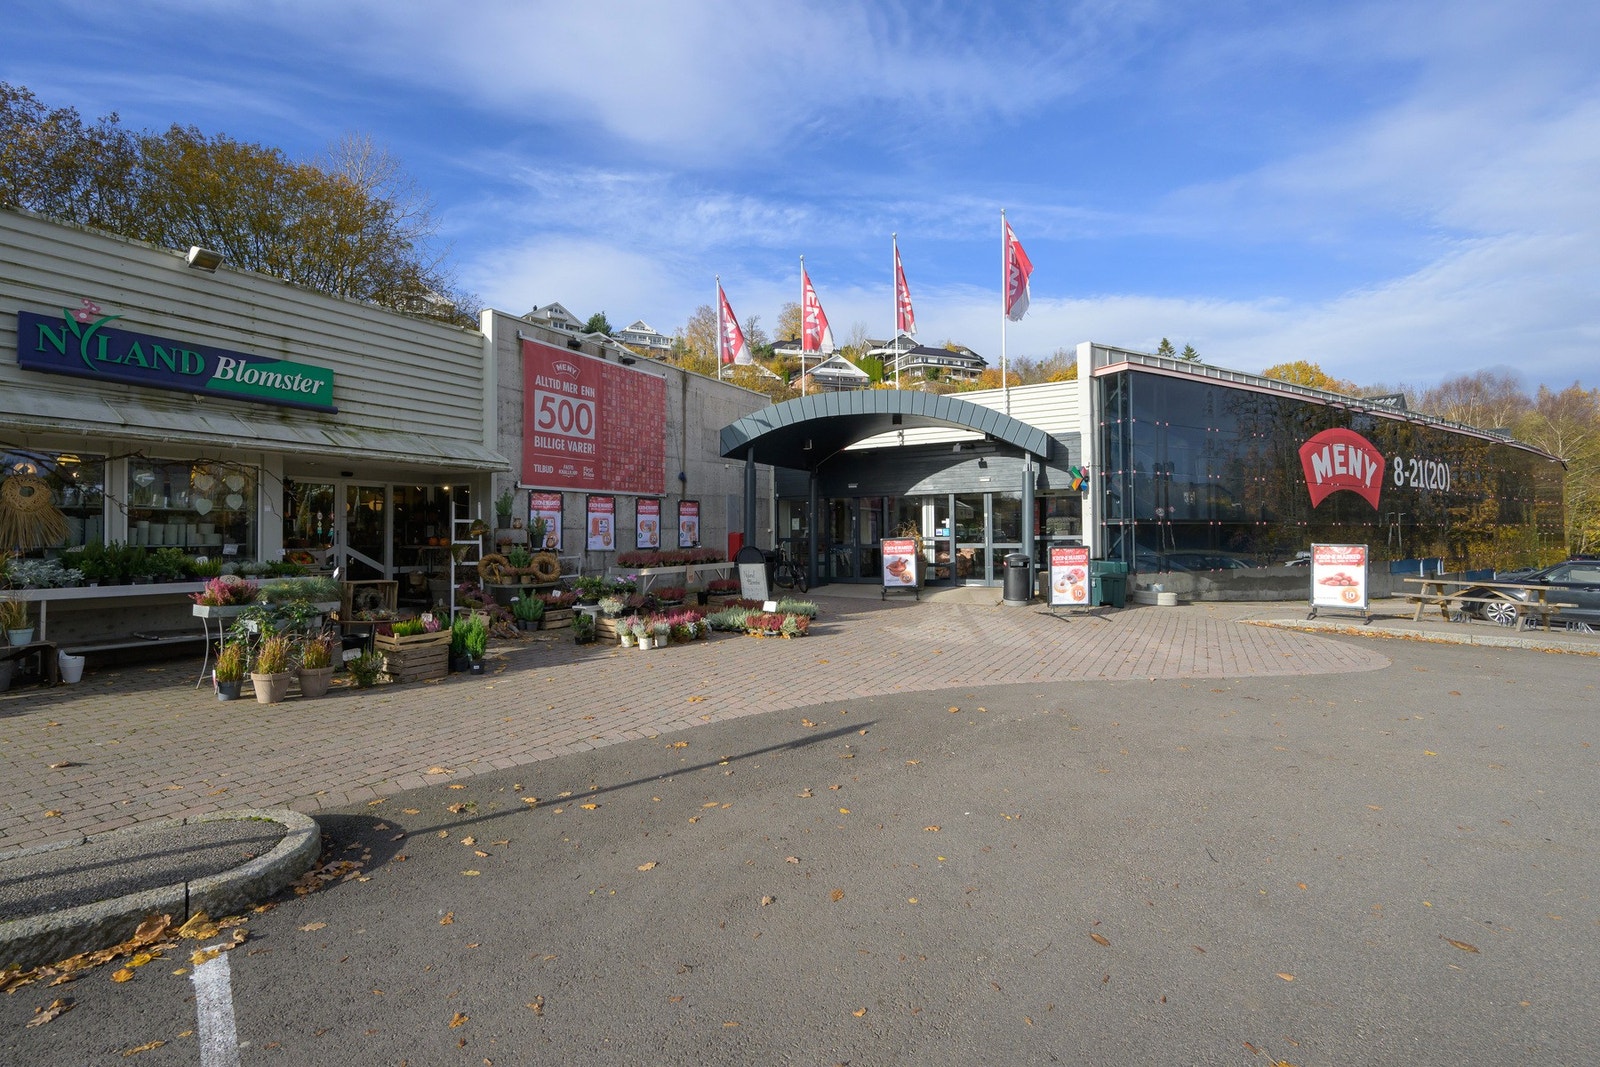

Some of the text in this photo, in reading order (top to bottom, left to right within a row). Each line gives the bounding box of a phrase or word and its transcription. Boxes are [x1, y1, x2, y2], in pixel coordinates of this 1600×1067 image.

[35, 308, 325, 394] NYLAND Blomster
[556, 363, 577, 375] MENY
[535, 374, 595, 398] ALLTID MER ENN
[537, 395, 593, 436] 500
[534, 435, 596, 455] BILLIGE VARER!
[533, 463, 554, 474] TILBUD
[1311, 443, 1377, 487] MENY
[1394, 456, 1450, 492] 8-21(20)
[1074, 589, 1083, 598] 10
[1344, 591, 1356, 600] 10
